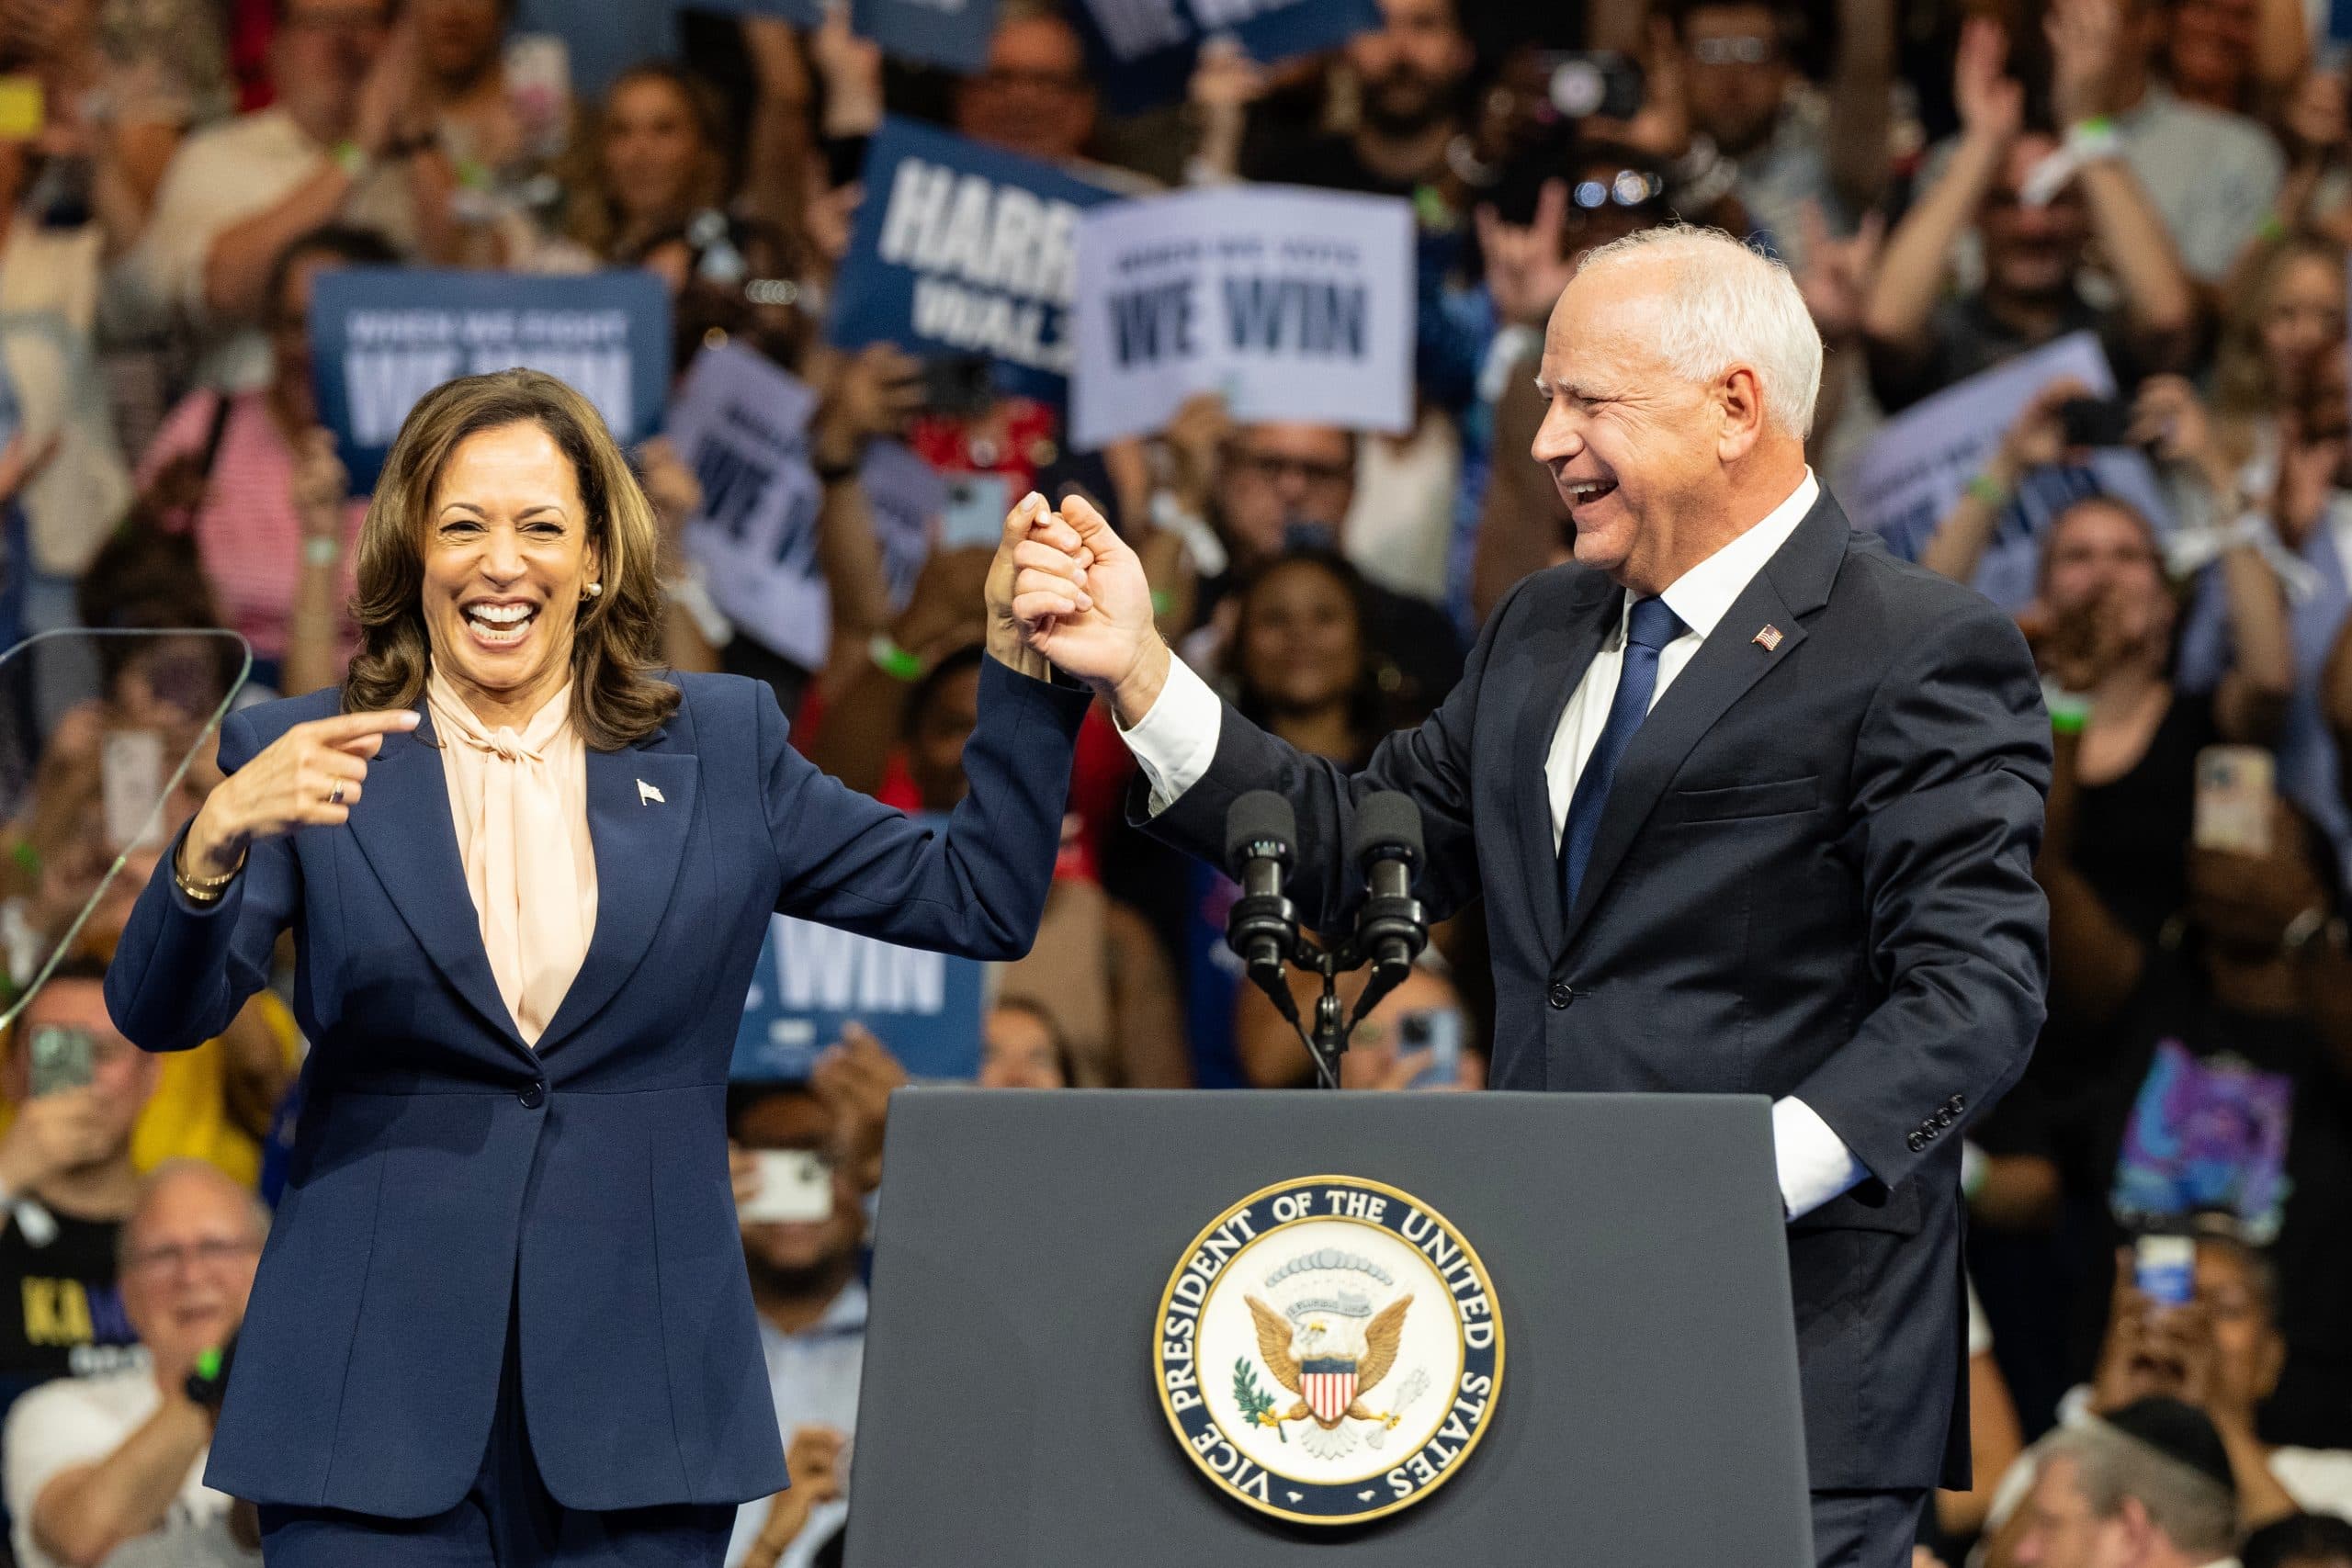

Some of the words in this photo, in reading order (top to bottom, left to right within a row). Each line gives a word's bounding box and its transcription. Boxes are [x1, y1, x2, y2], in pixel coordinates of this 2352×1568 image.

[1109, 278, 1193, 369] WE
[1219, 275, 1368, 357] WIN
[1272, 1191, 1312, 1221] OF
[1325, 1190, 1386, 1224] THE
[1163, 1208, 1257, 1413] PRESIDENT
[1399, 1209, 1494, 1348] UNITED
[1193, 1423, 1272, 1504] VICE
[1385, 1372, 1493, 1498] STATES
